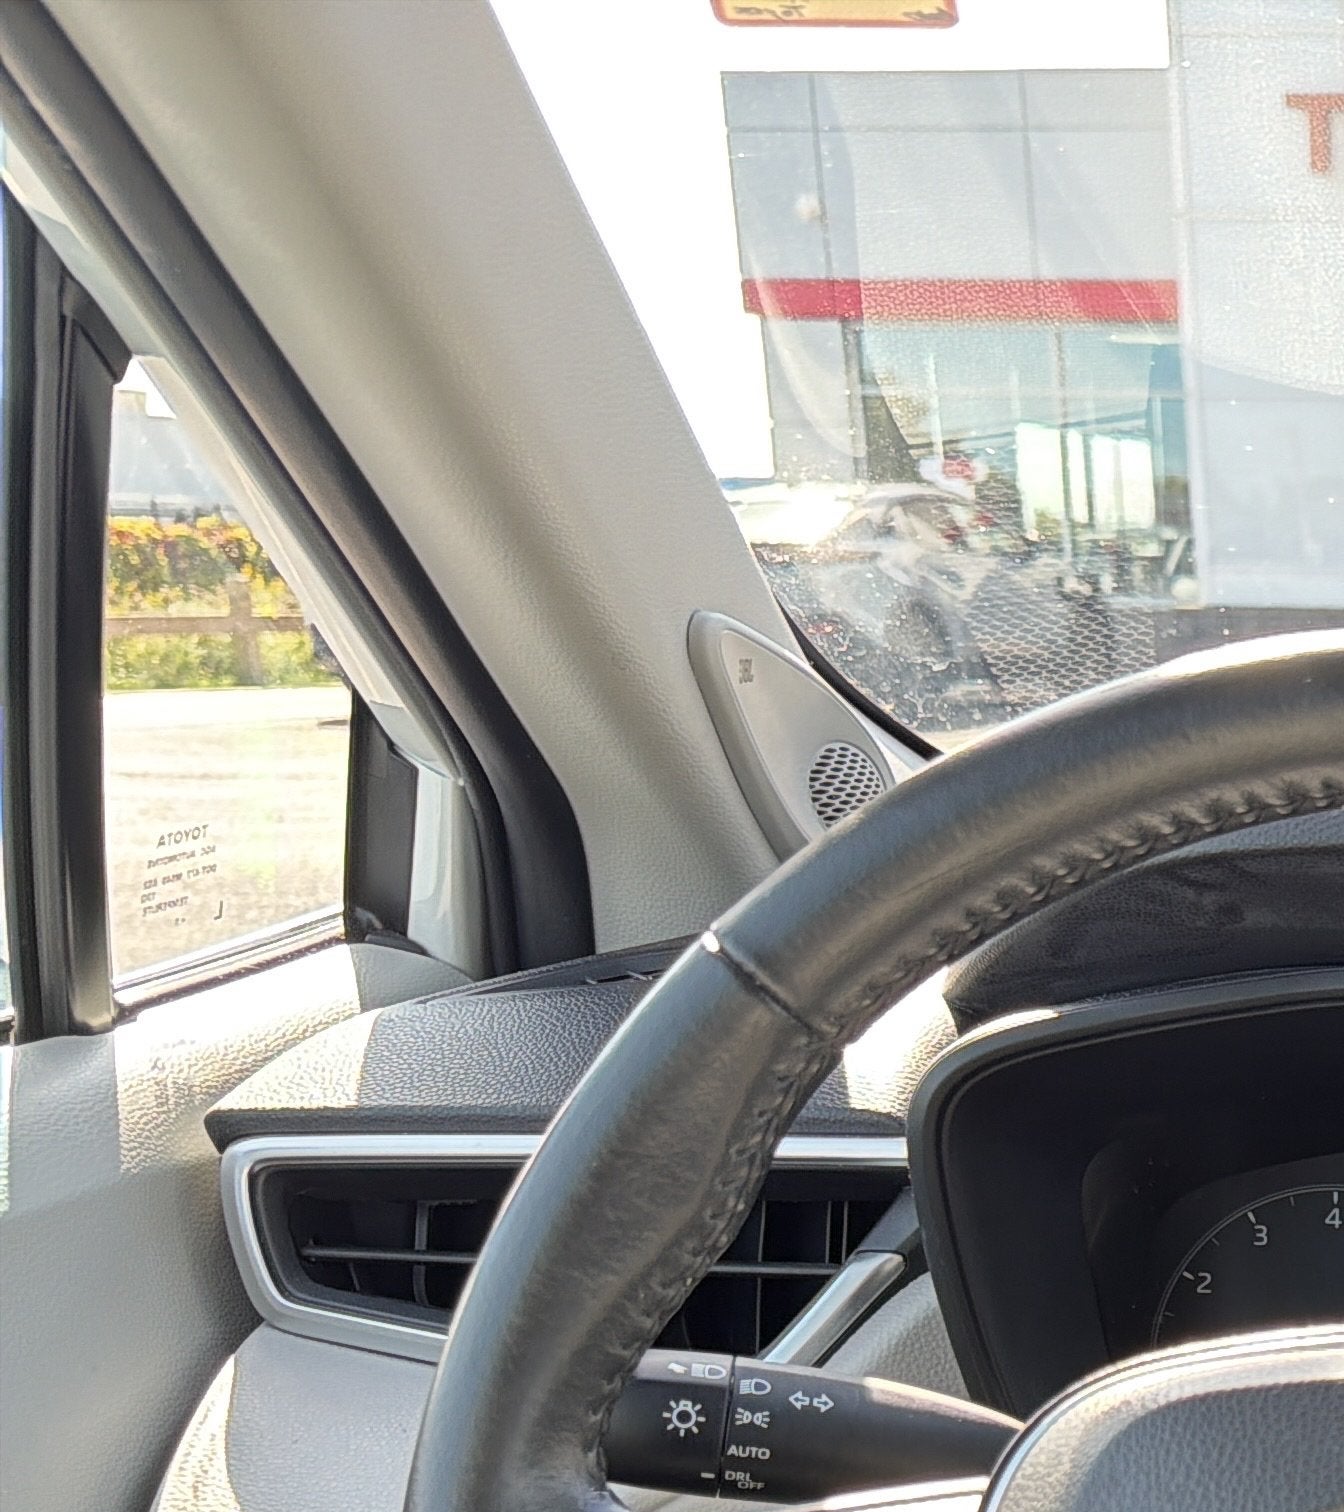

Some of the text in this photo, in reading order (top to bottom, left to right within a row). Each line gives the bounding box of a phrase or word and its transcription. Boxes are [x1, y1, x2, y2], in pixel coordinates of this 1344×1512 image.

[1325, 1208, 1342, 1229] 4
[1254, 1225, 1268, 1246] 3
[1196, 1273, 1212, 1294] 2
[727, 1446, 770, 1460] AUTO
[725, 1471, 752, 1482] DRL
[737, 1480, 765, 1490] OFF
